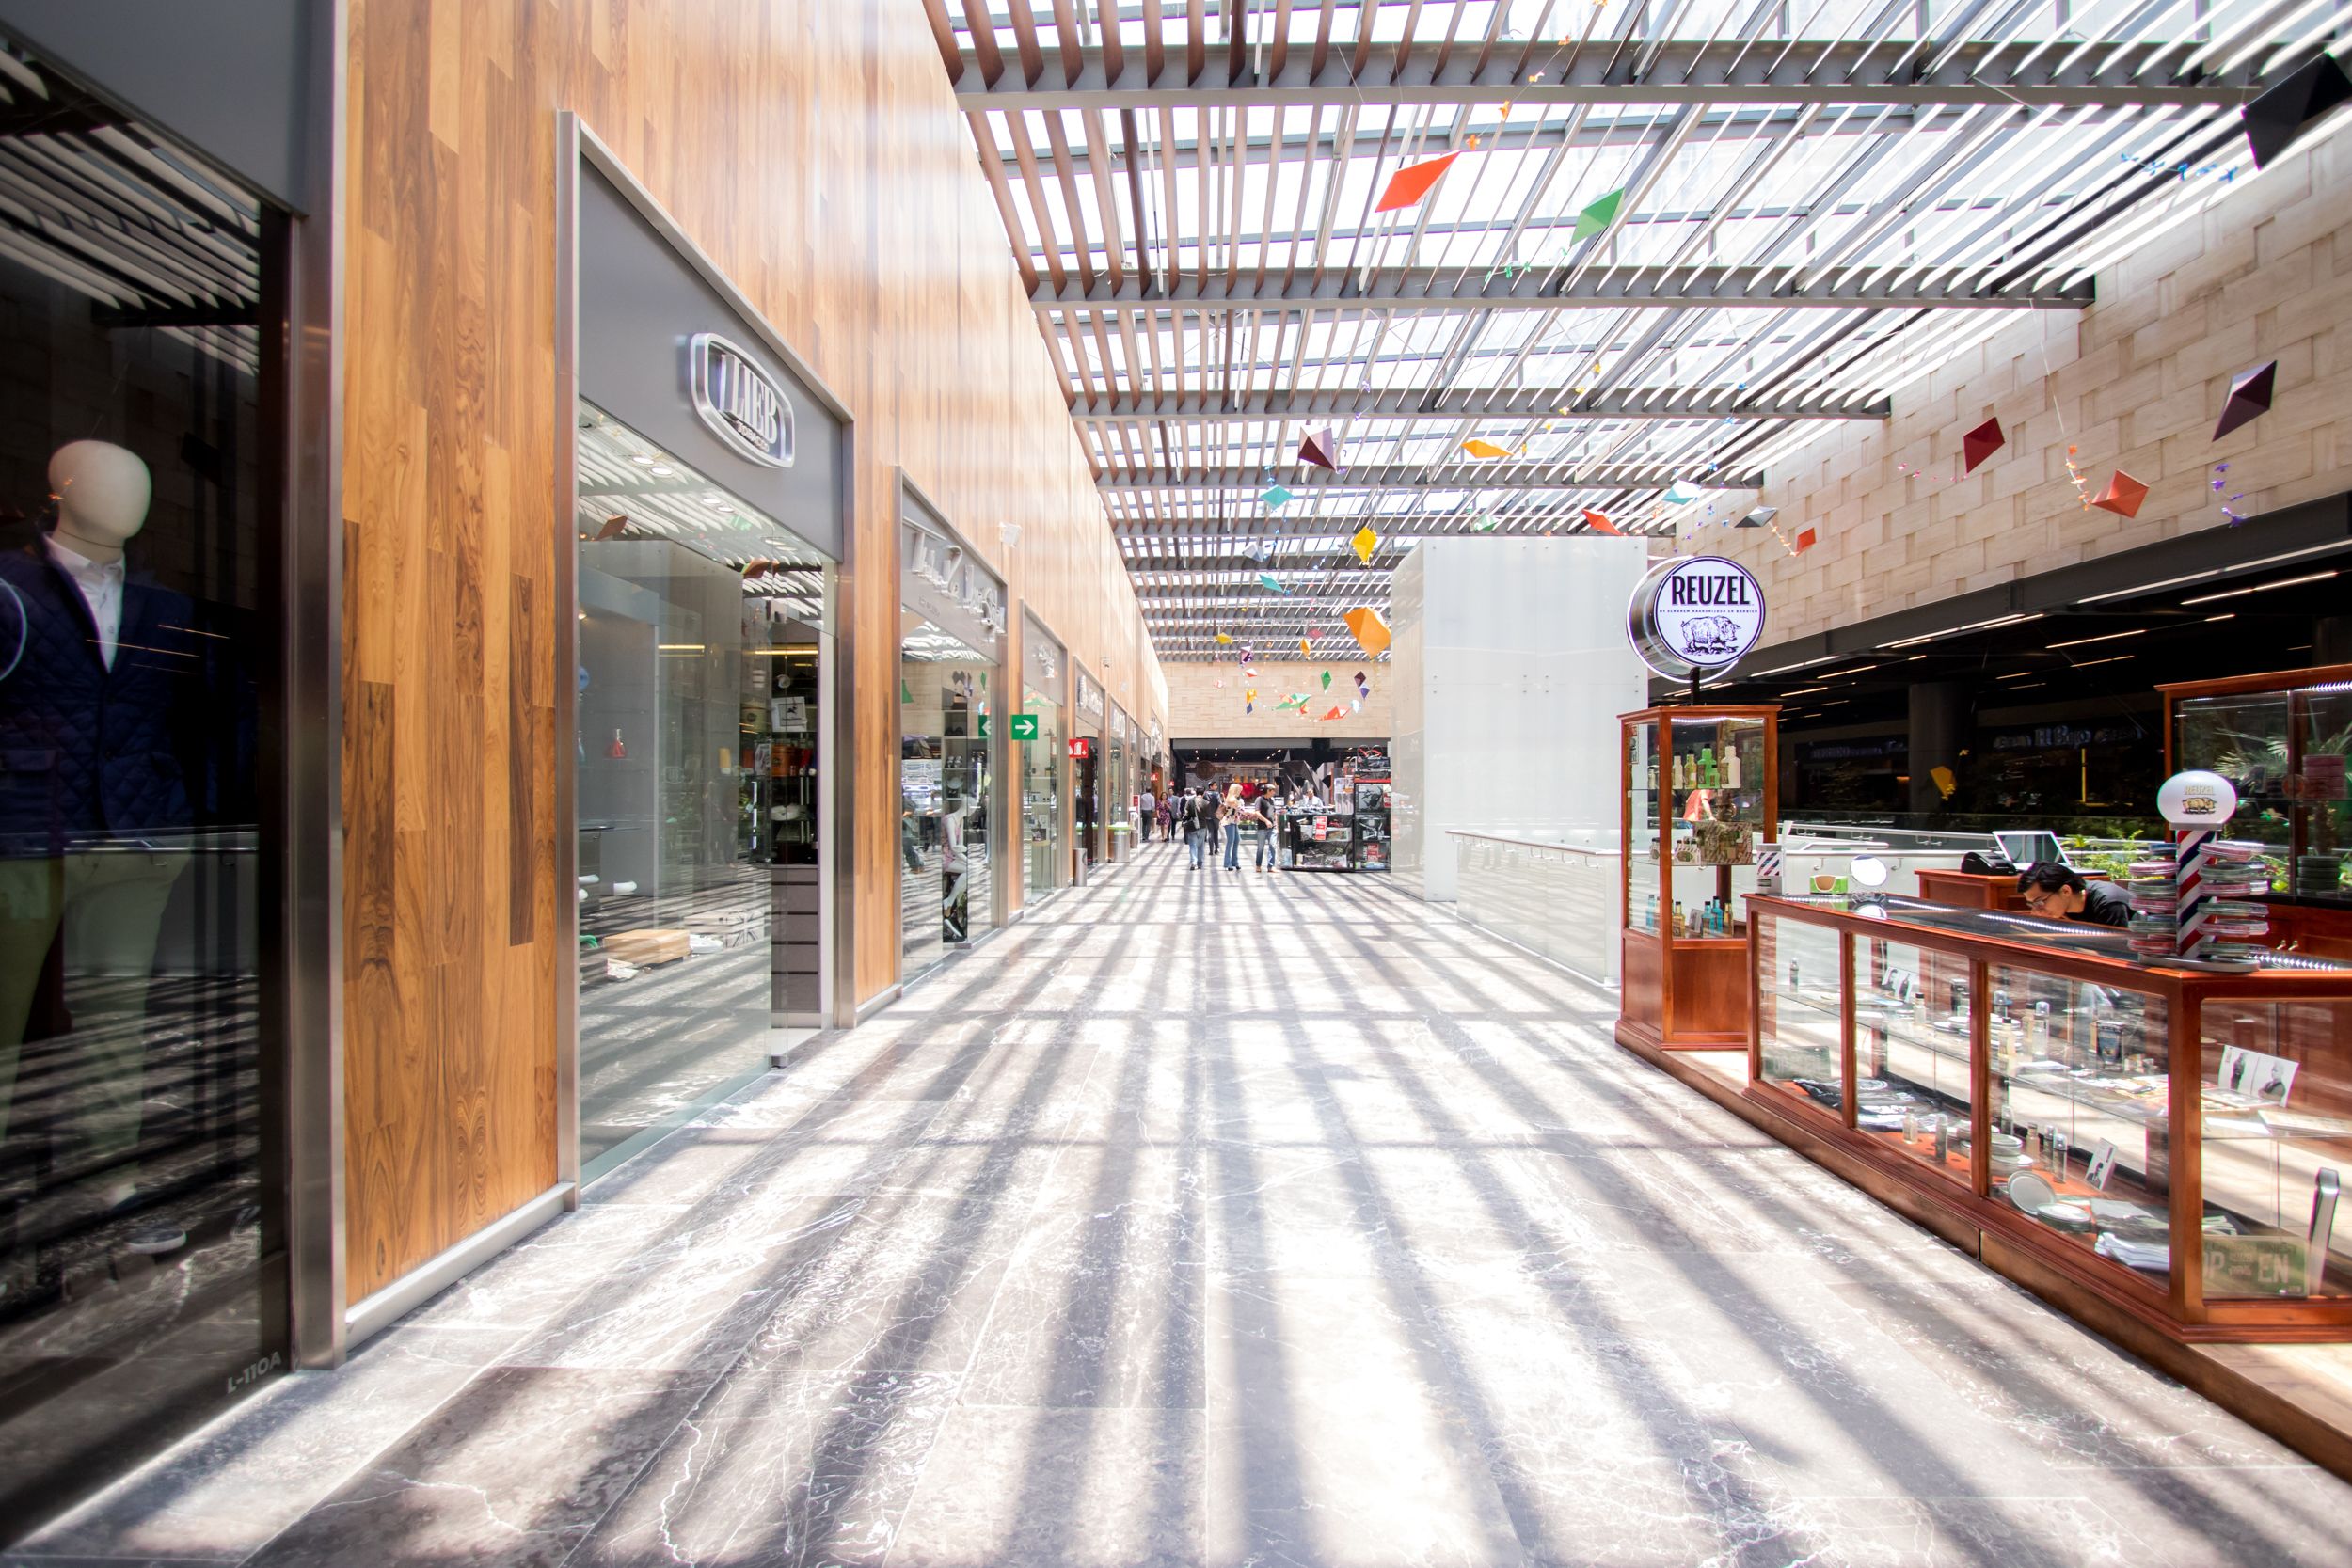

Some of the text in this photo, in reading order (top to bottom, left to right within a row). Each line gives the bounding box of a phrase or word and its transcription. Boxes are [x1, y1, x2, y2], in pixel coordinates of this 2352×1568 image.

[726, 354, 778, 444] LIEB
[1671, 575, 1751, 605] REUZEL
[227, 1351, 282, 1394] L-110A
